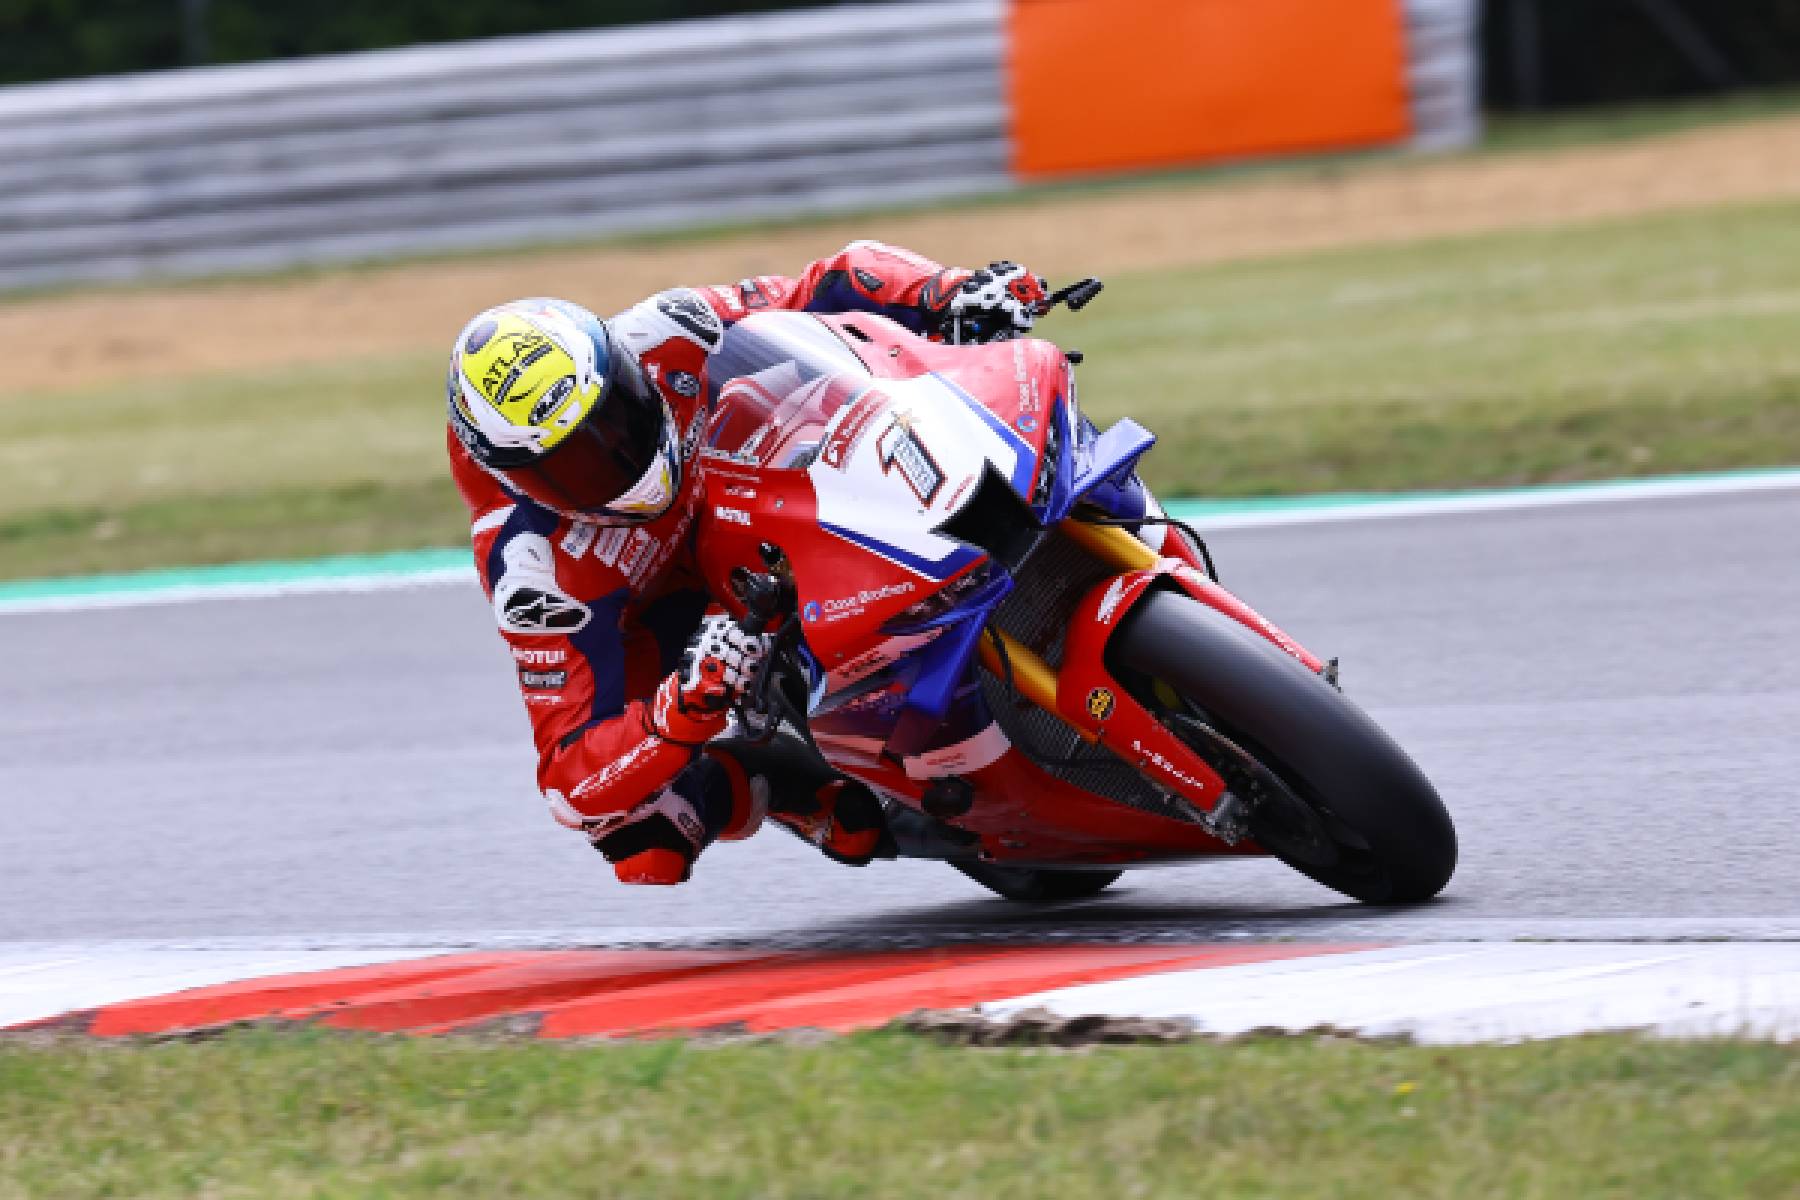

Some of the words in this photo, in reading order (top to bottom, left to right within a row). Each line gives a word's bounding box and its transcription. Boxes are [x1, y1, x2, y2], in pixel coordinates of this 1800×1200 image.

[483, 329, 544, 396] ATLAS
[531, 377, 575, 424] HJC
[875, 420, 949, 511] 1
[823, 593, 857, 614] Close
[857, 580, 916, 606] Brothers
[511, 646, 567, 664] MOTUL
